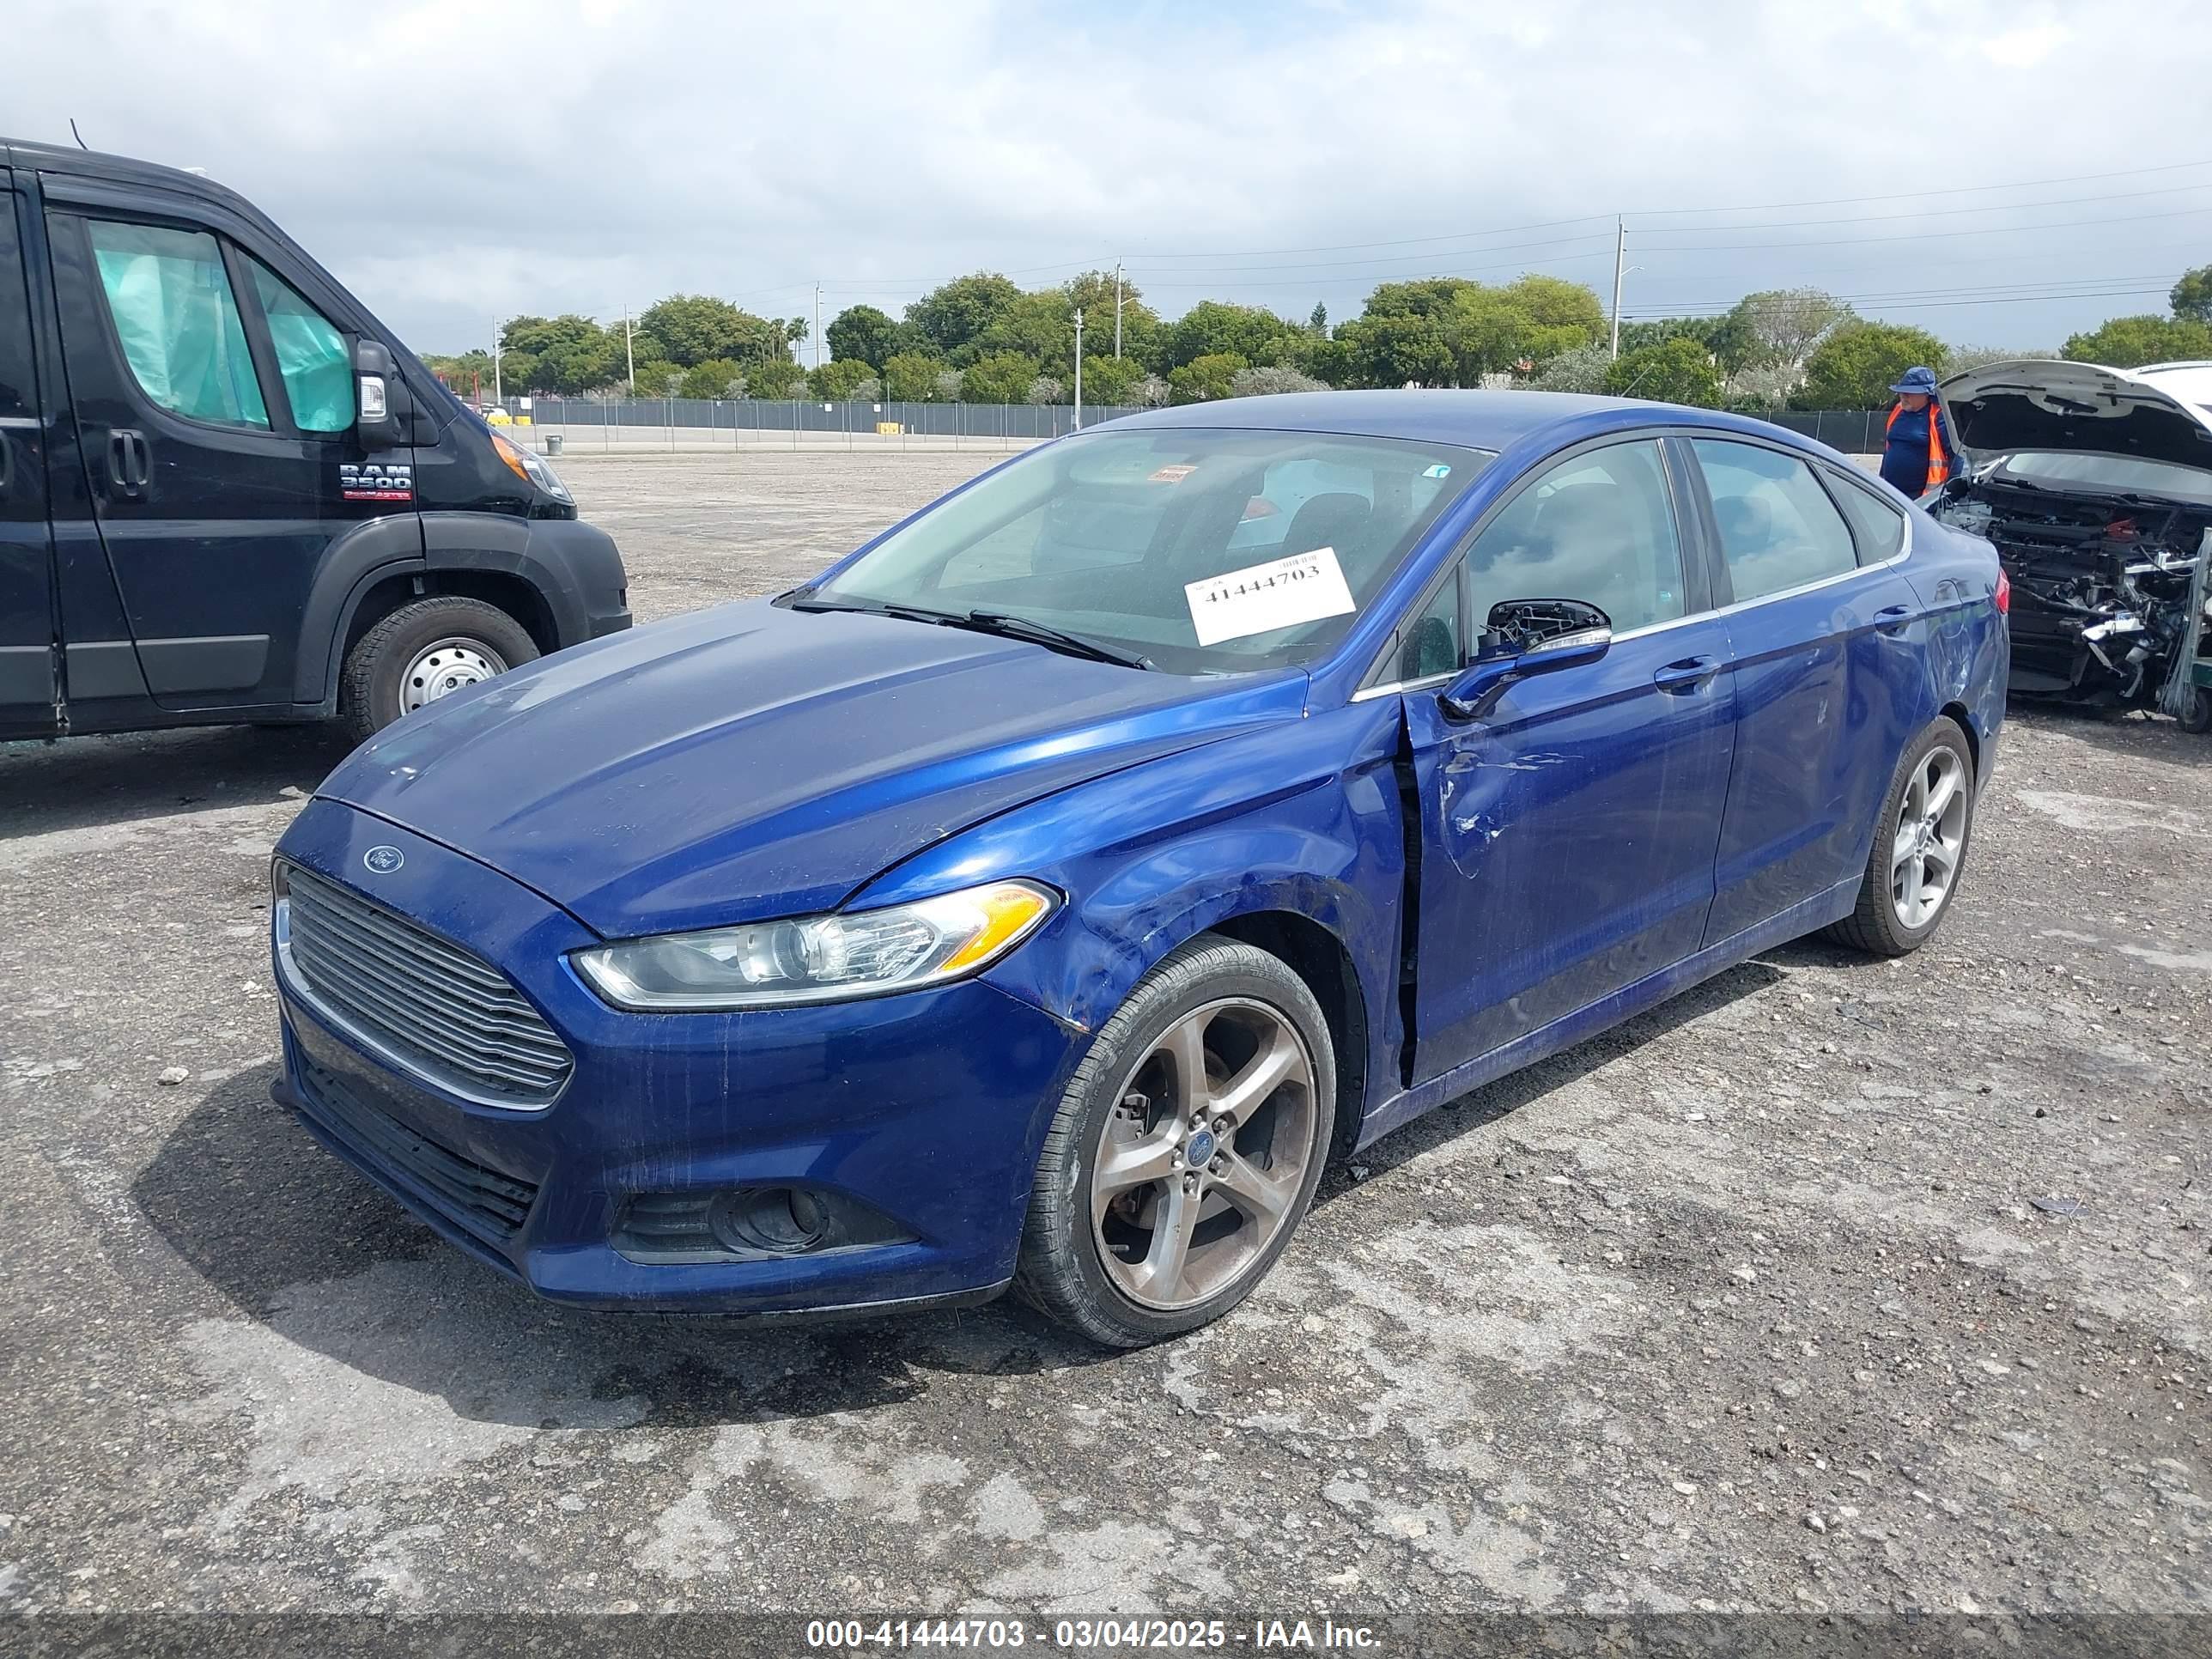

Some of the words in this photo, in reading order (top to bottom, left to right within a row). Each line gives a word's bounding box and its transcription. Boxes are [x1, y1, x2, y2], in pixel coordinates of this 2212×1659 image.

[339, 465, 411, 477] RAM
[340, 477, 412, 489] 3500
[1205, 565, 1321, 604] 41444703
